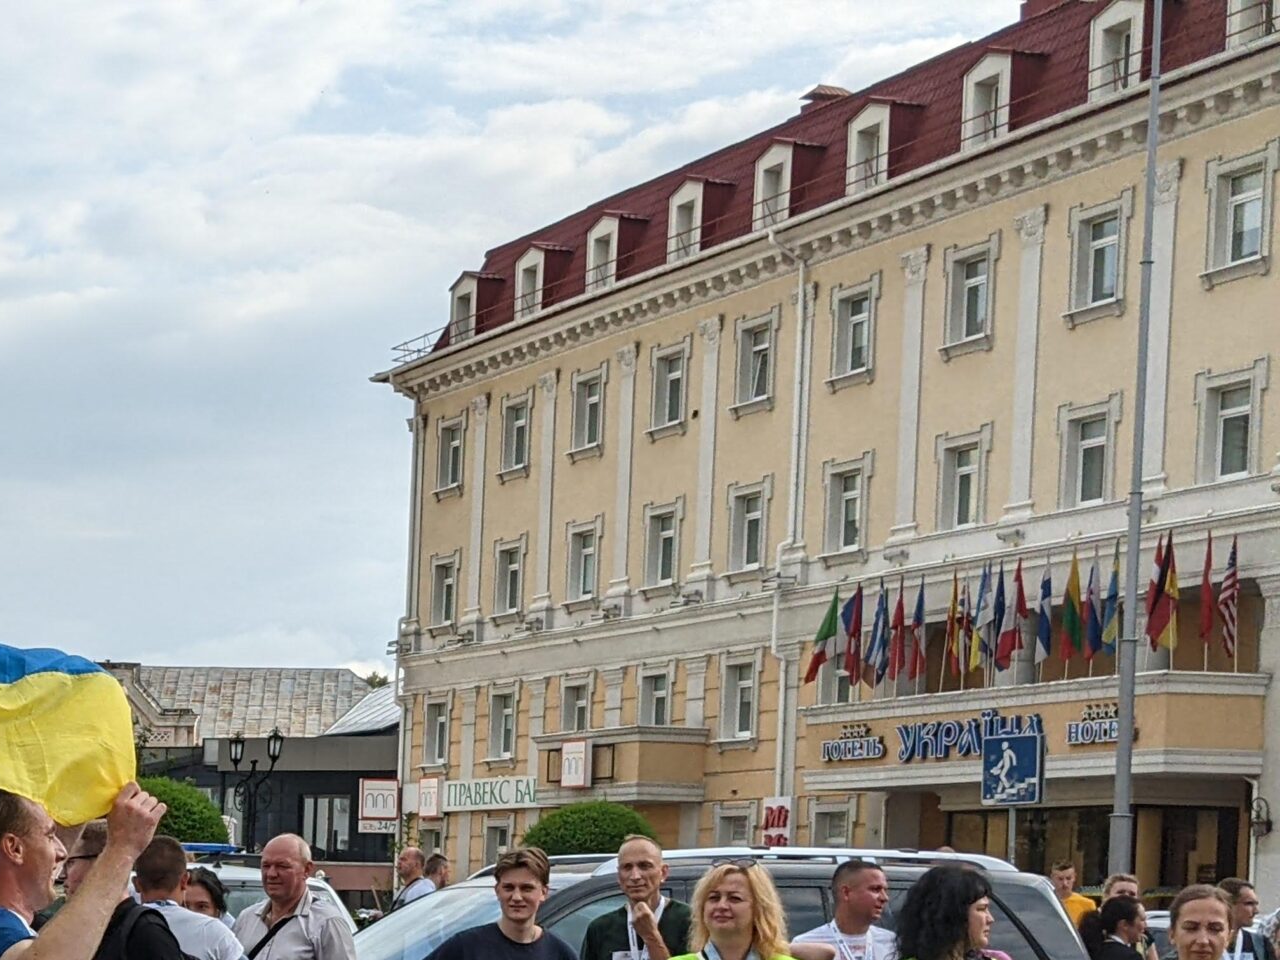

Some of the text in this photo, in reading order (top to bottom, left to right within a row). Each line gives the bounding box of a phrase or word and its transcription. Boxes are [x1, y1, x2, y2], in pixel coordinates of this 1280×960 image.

[820, 708, 1119, 763] ГОТЕЛЬ УКРАЇНА HOTE
[447, 780, 510, 807] ПРАВЕКС
